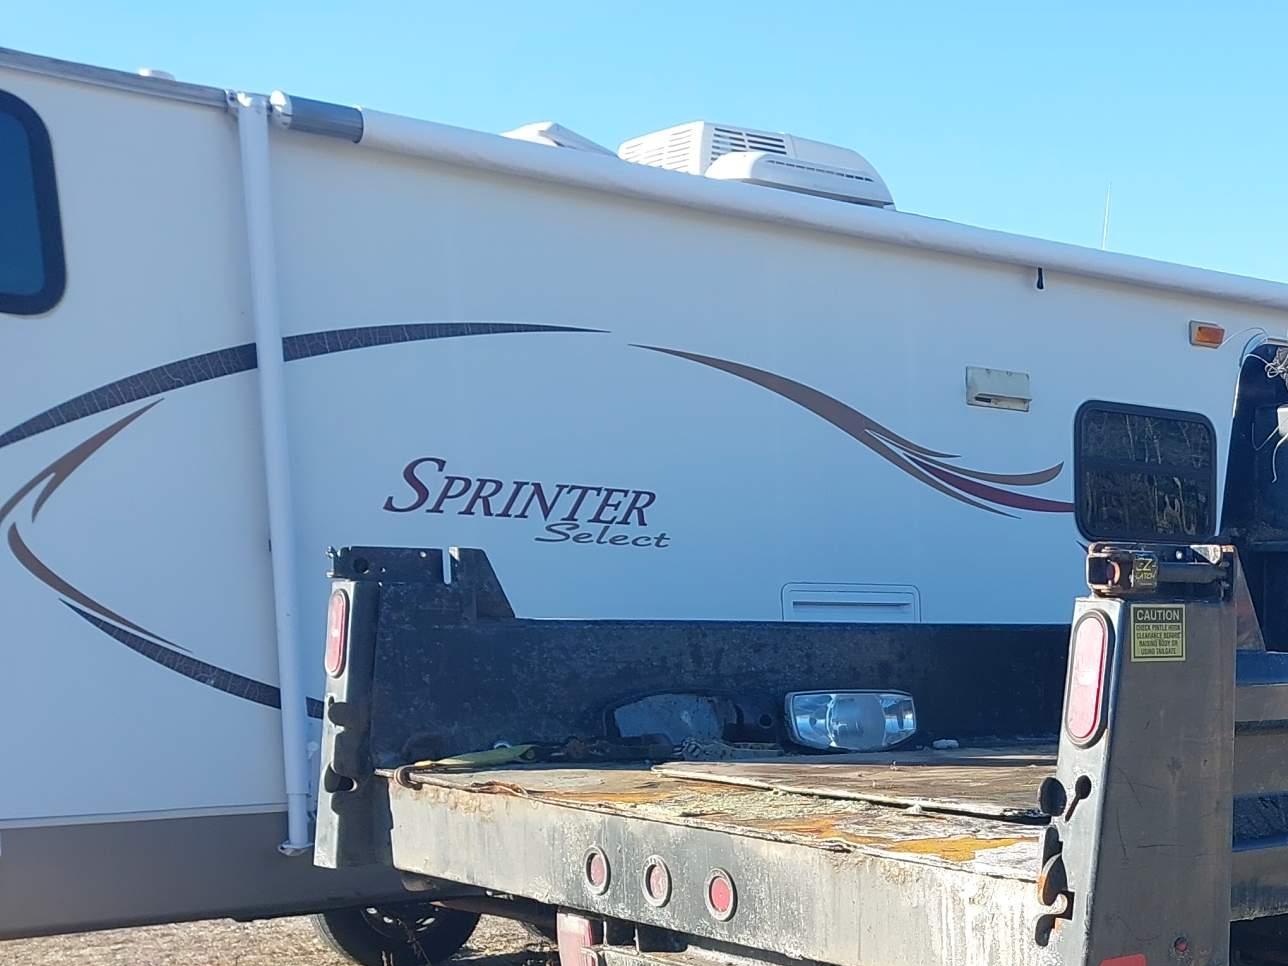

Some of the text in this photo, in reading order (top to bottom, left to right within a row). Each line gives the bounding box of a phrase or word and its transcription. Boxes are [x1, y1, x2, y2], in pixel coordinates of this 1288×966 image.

[382, 456, 657, 527] SPRINTER
[534, 521, 671, 548] Select
[1136, 609, 1180, 621] CAUTION
